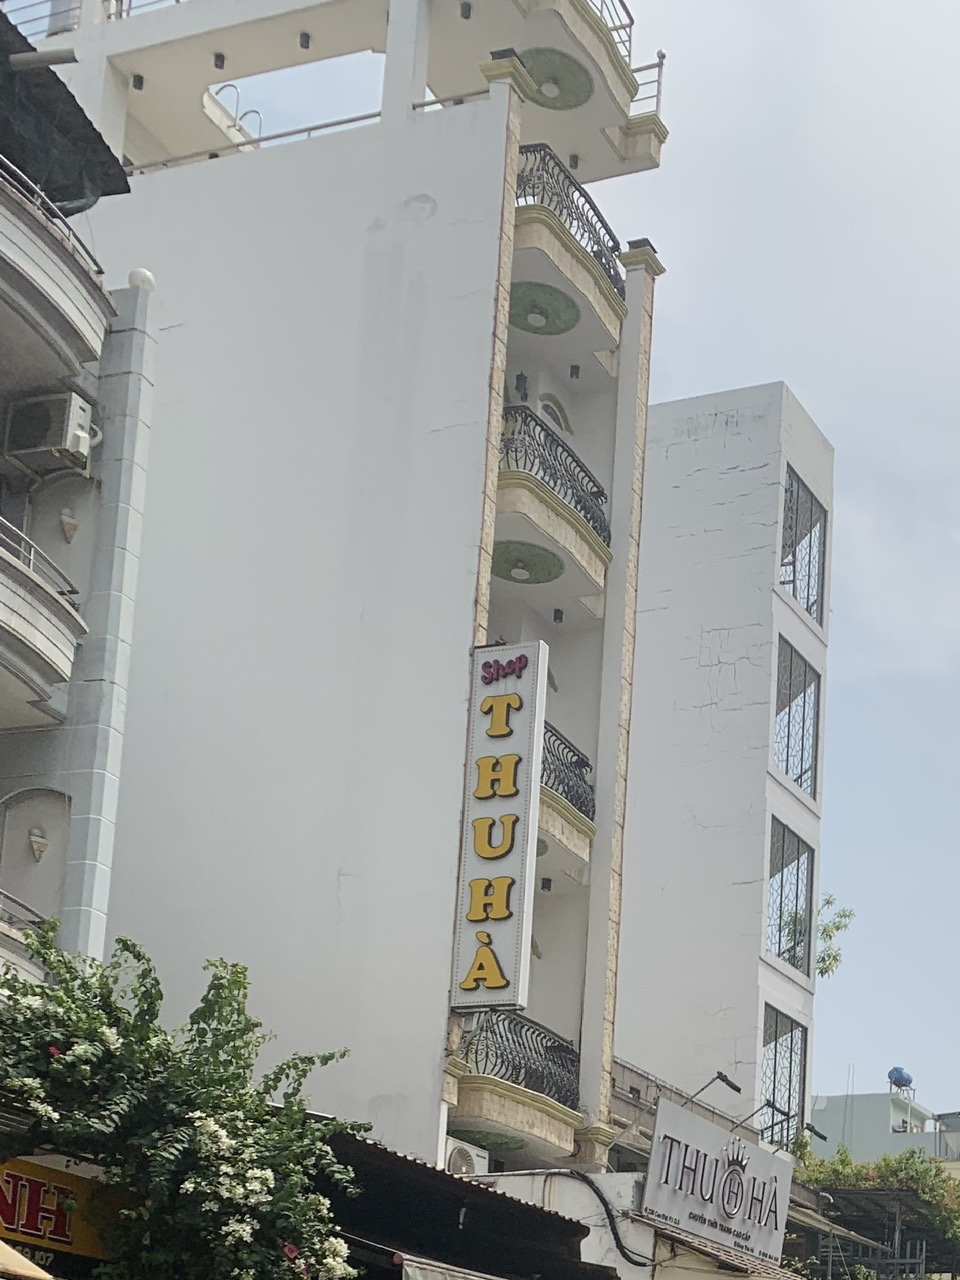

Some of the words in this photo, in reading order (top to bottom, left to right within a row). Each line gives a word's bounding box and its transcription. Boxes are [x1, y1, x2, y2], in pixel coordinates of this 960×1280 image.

[481, 654, 528, 685] Shop
[659, 1133, 719, 1204] THU
[746, 1174, 779, 1232] HÀ
